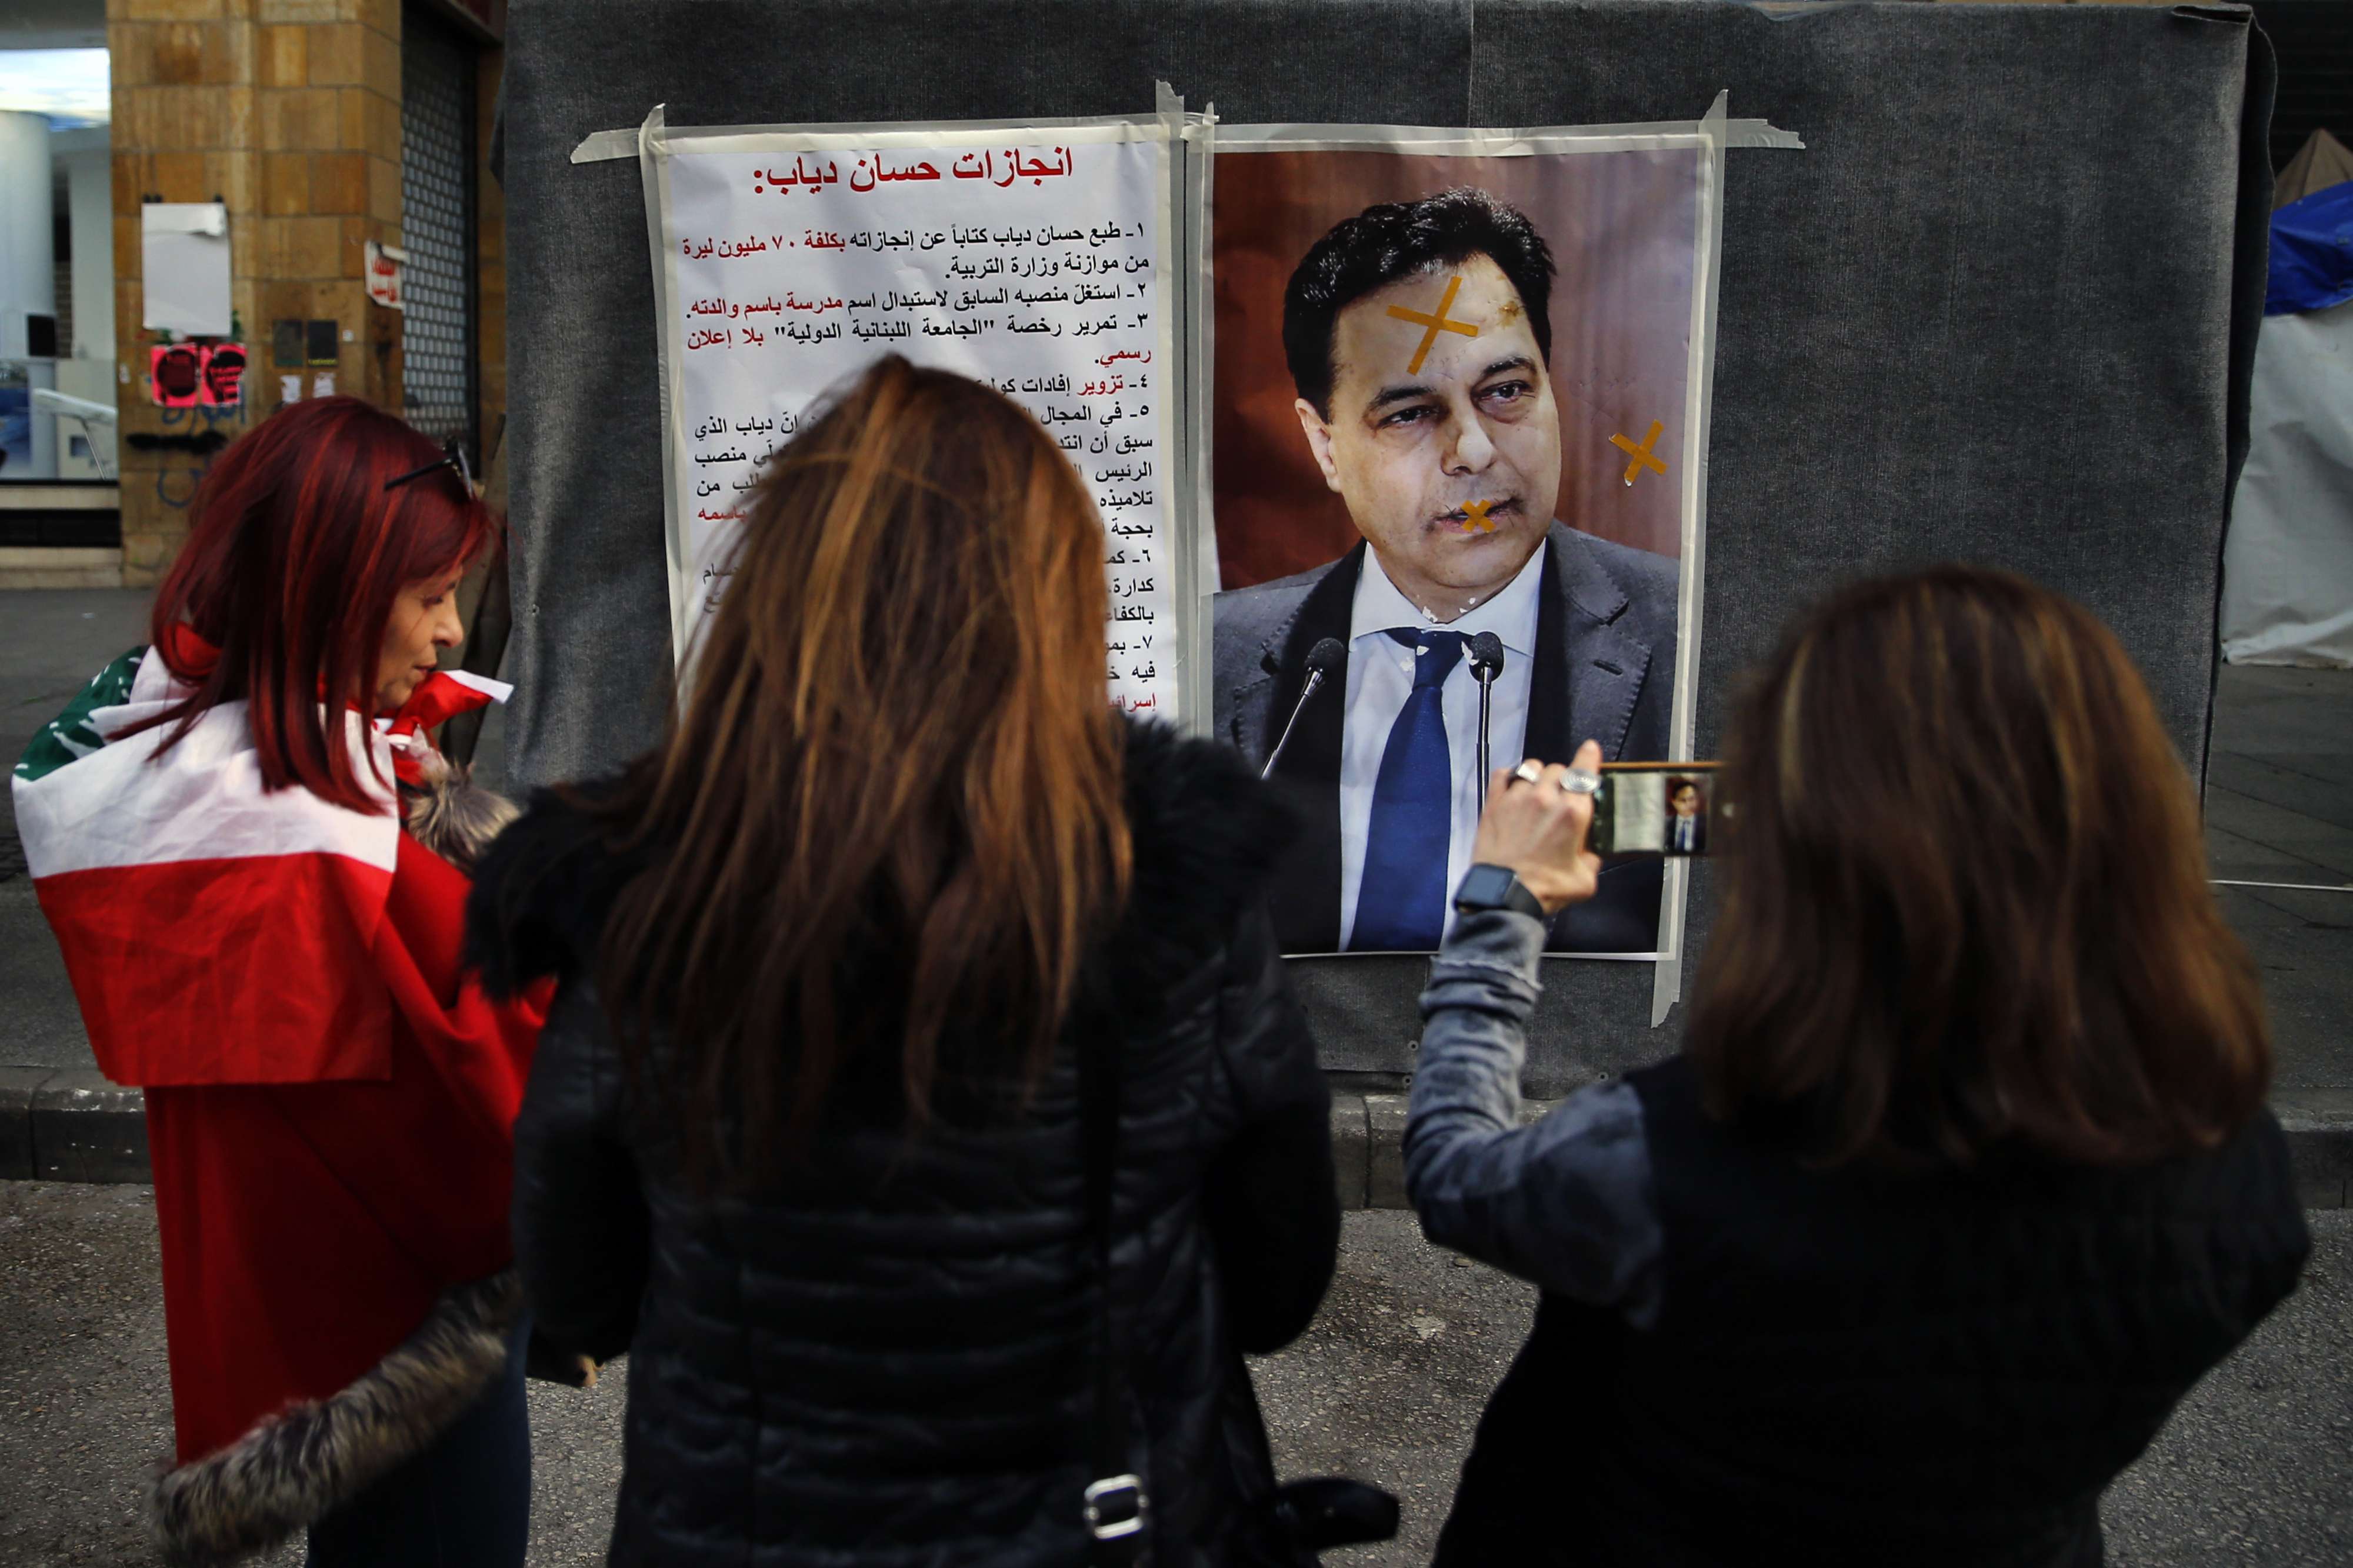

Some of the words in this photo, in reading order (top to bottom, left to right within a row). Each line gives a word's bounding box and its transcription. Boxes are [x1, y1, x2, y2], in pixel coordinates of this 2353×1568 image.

[753, 155, 838, 195] دياب:
[849, 153, 941, 192] حسان
[952, 146, 1072, 188] انجازات
[771, 235, 795, 250] ٧٠
[804, 229, 846, 253] بكلفة
[849, 229, 914, 252] إنجازاته
[919, 232, 946, 251] عن
[951, 223, 988, 249] كتاباً
[992, 226, 1032, 248] دياب
[1036, 225, 1085, 246] حسان
[1089, 220, 1121, 248] طبع
[682, 237, 714, 259] ليرة
[718, 235, 766, 258] مليون
[945, 255, 1004, 280] التربية.
[1010, 256, 1059, 278] وزارة
[1063, 251, 1119, 275] موازنة
[1124, 255, 1149, 273] من
[686, 297, 739, 319] والدته.
[785, 291, 843, 315] مدرسة
[847, 292, 876, 316] اسم
[881, 289, 948, 312] لاستبدال
[954, 286, 1009, 312] السابق
[1014, 285, 1069, 308] منصبه
[744, 296, 782, 321] باسم
[851, 318, 911, 343] اللبنانية
[1006, 314, 1062, 338] رخصة
[1071, 313, 1118, 336] تمرير
[687, 328, 732, 350] إعلان
[741, 326, 764, 347] بلا
[1094, 349, 1152, 369] رسمي.
[1021, 373, 1071, 397] إفادات
[1076, 374, 1124, 396] تزوير
[735, 416, 774, 436] دياب
[1040, 404, 1092, 426] المجال
[1099, 401, 1122, 428] في
[694, 415, 728, 442] الذي
[1089, 430, 1108, 454] أن
[1115, 435, 1153, 455] سبق
[694, 446, 747, 468] منصب
[1095, 461, 1152, 483] الرئيس
[696, 480, 721, 497] من
[1099, 488, 1153, 512] تلاميذه
[1111, 517, 1154, 540] بحجة
[1131, 660, 1156, 683] فيه
